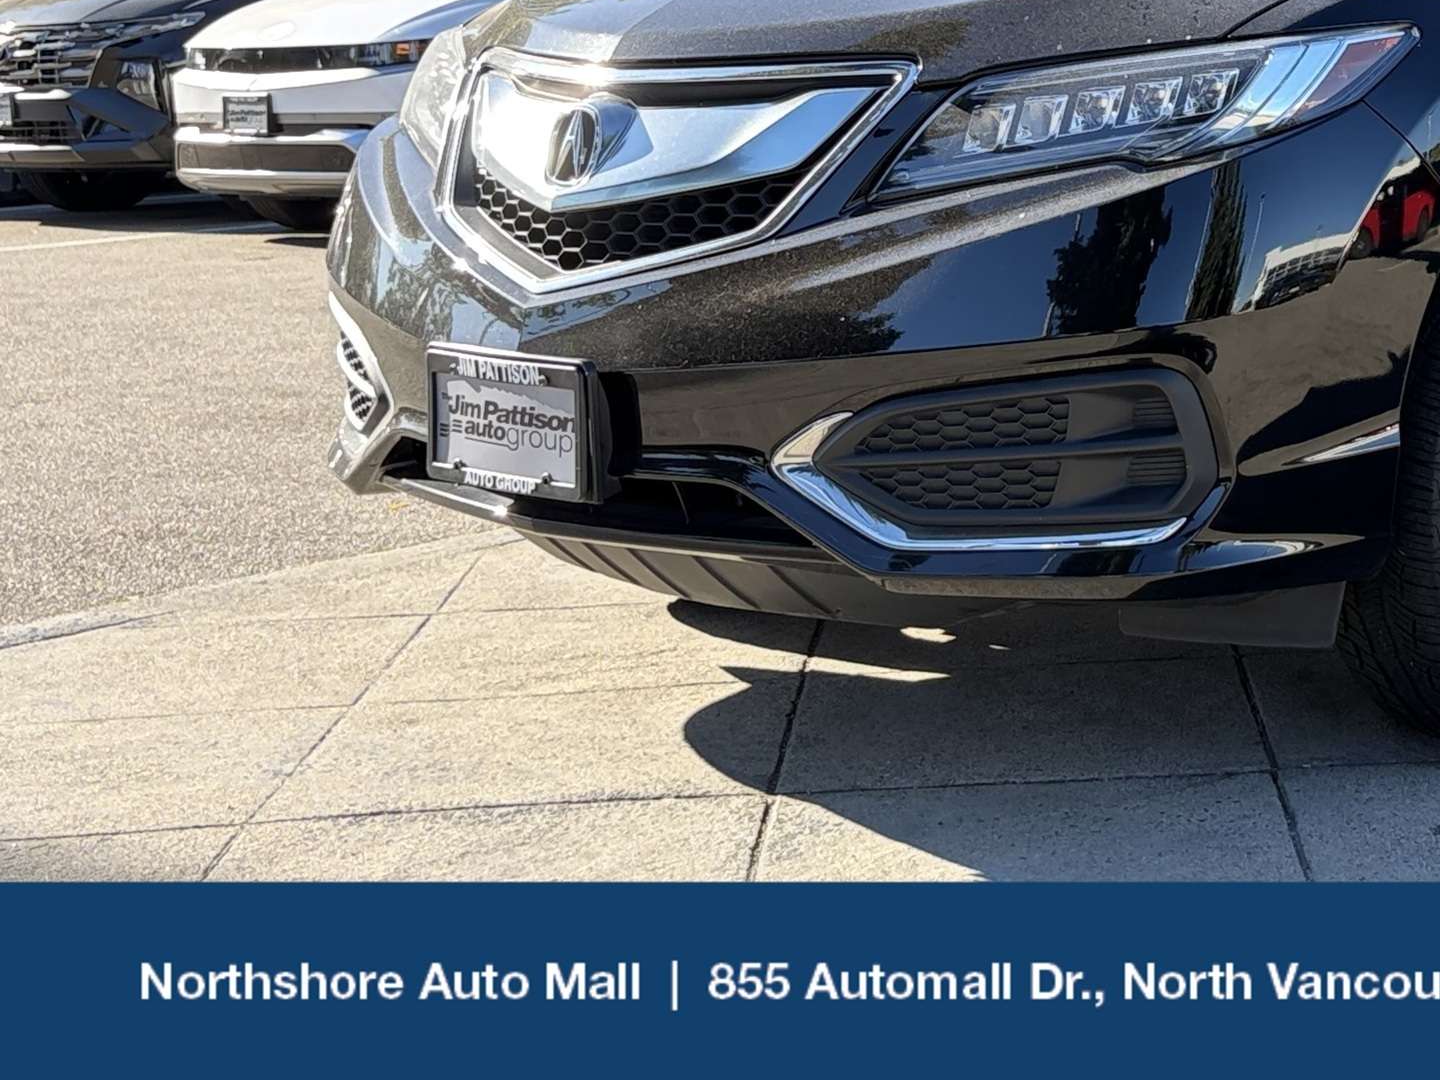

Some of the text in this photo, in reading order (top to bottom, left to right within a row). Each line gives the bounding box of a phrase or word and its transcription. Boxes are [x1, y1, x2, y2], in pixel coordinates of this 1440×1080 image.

[457, 357, 541, 387] JIM PATTISON
[464, 471, 537, 495] AUTO GROUP
